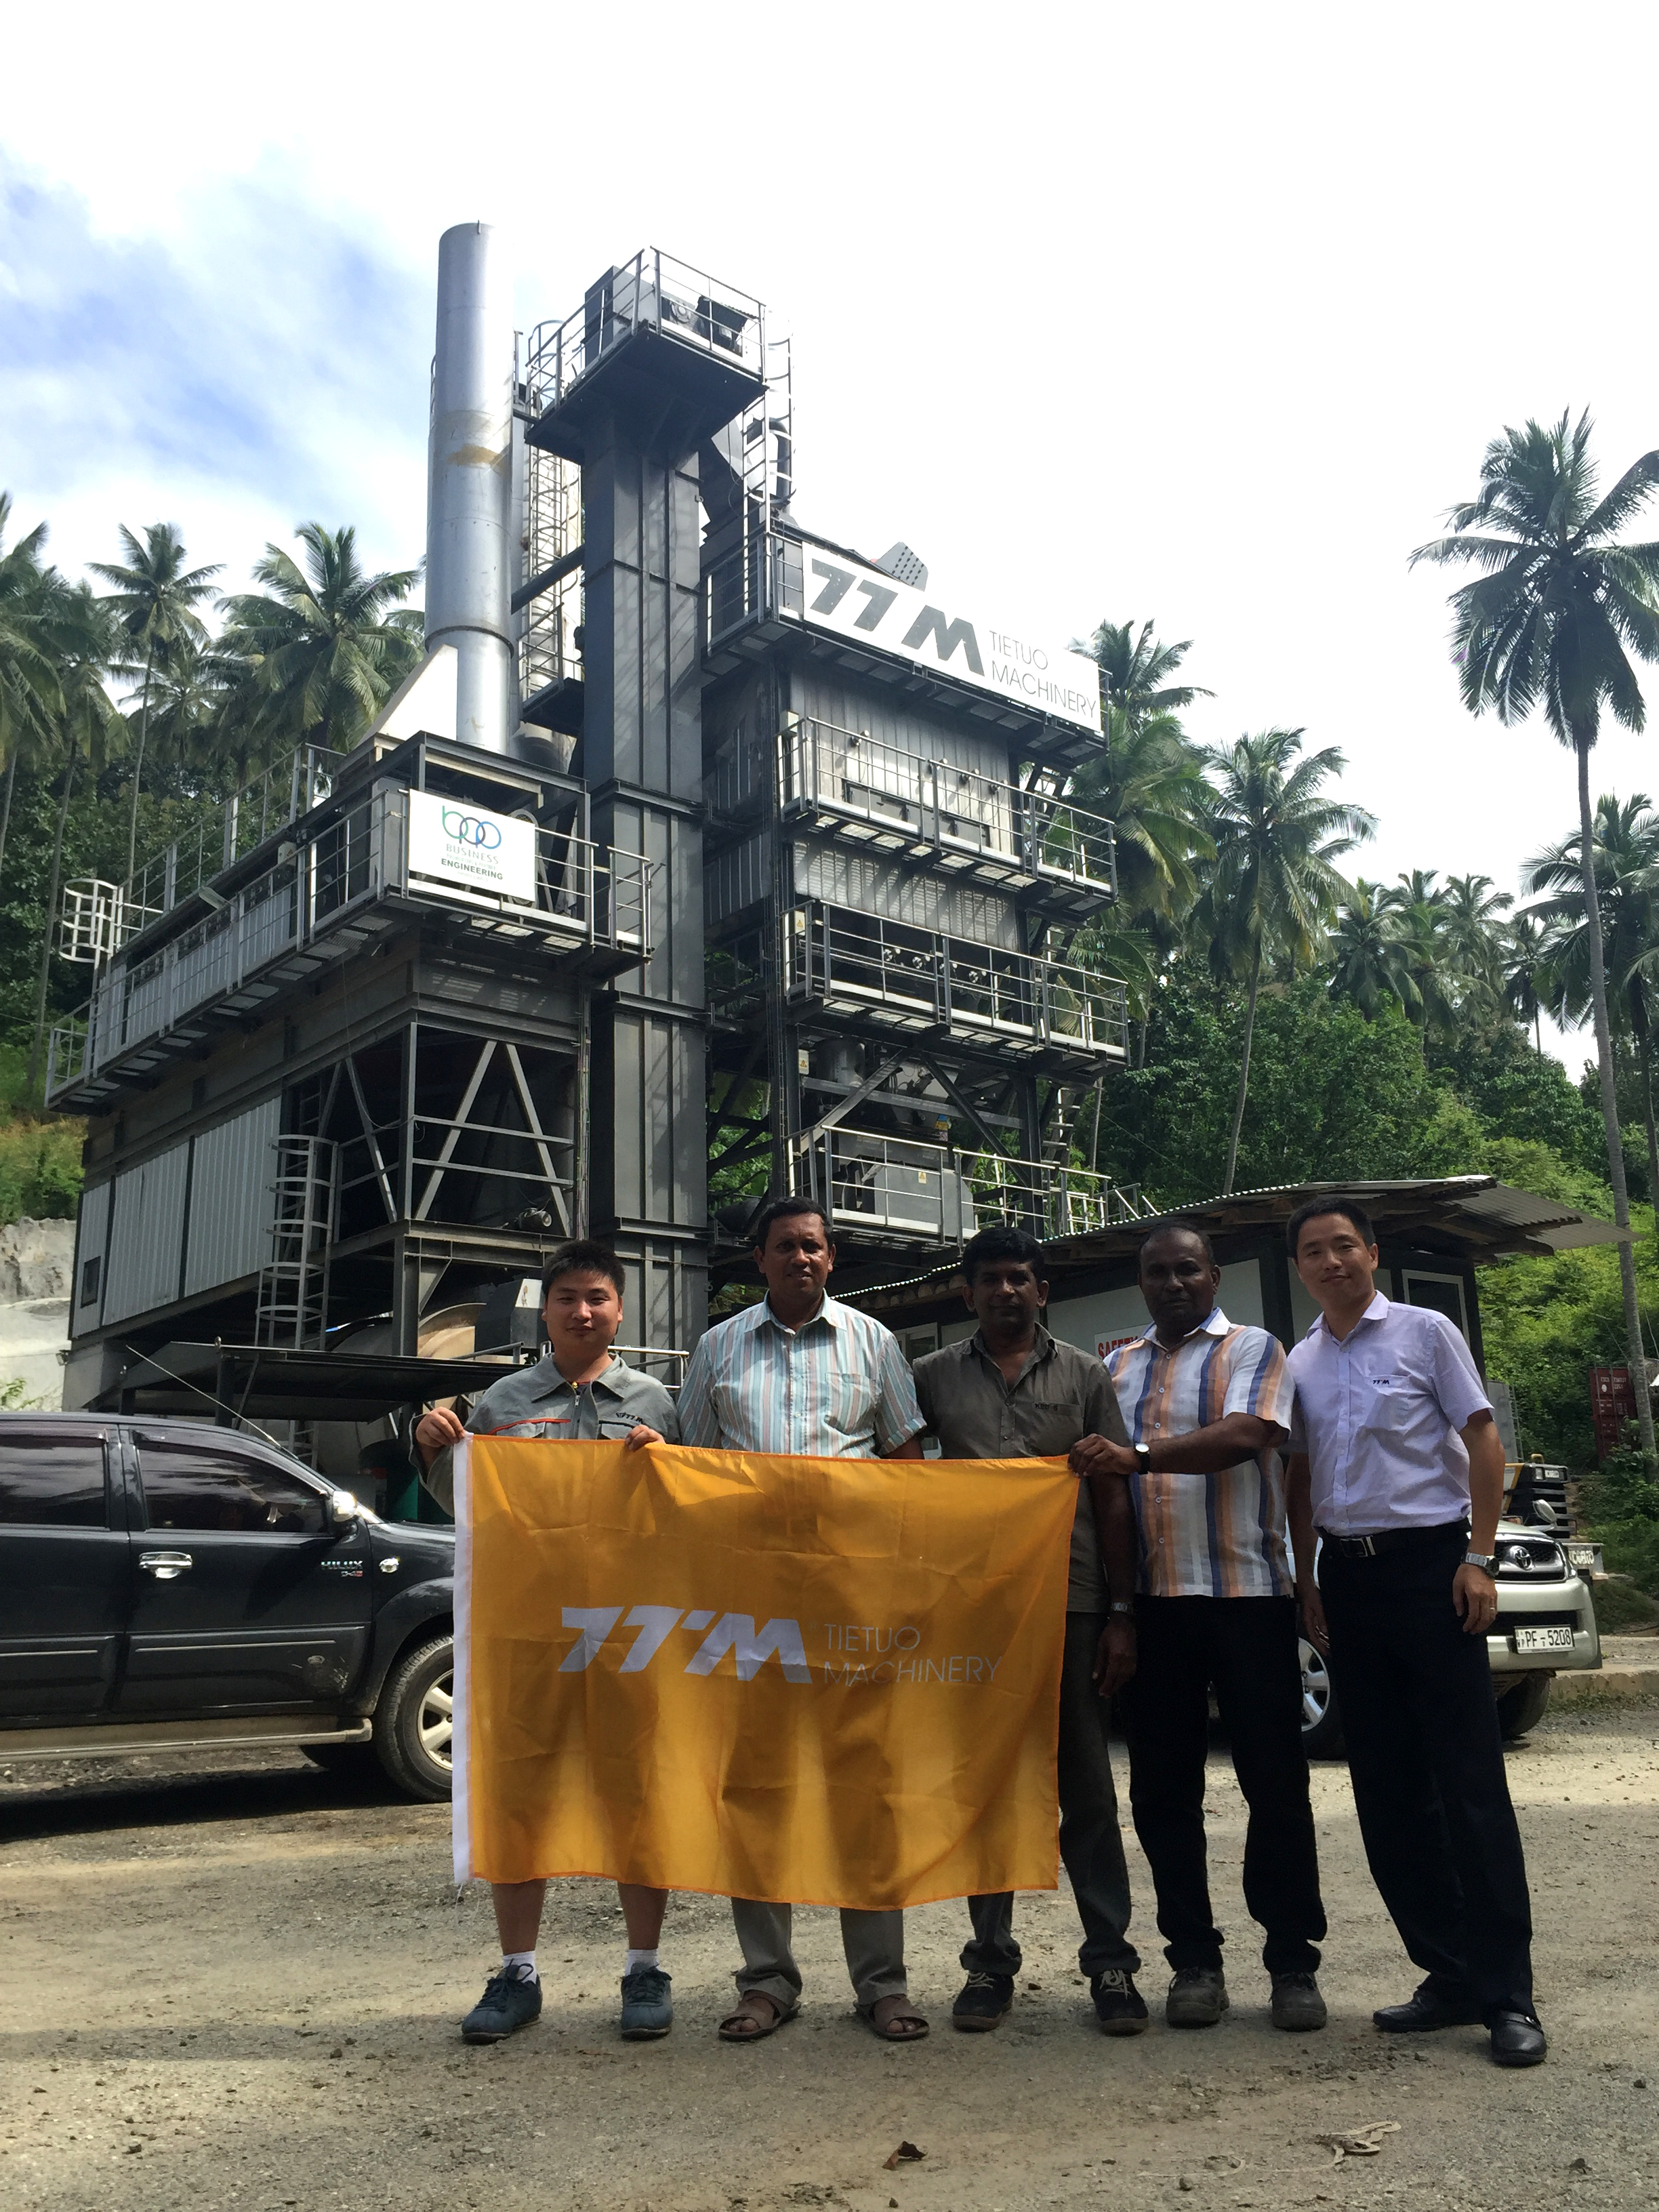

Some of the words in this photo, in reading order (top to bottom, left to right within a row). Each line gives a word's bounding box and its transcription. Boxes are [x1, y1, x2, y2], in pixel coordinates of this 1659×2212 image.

[810, 558, 985, 676] TTM
[989, 630, 1048, 670] TIETUO
[991, 660, 1097, 718] MACHINERY
[441, 858, 503, 880] ENGINEERING
[446, 844, 499, 865] BUSINESS
[1098, 1336, 1139, 1360] SAF
[558, 1605, 813, 1684] TTM
[824, 1624, 920, 1653] TIETUO
[824, 1656, 1002, 1687] MACHINERY
